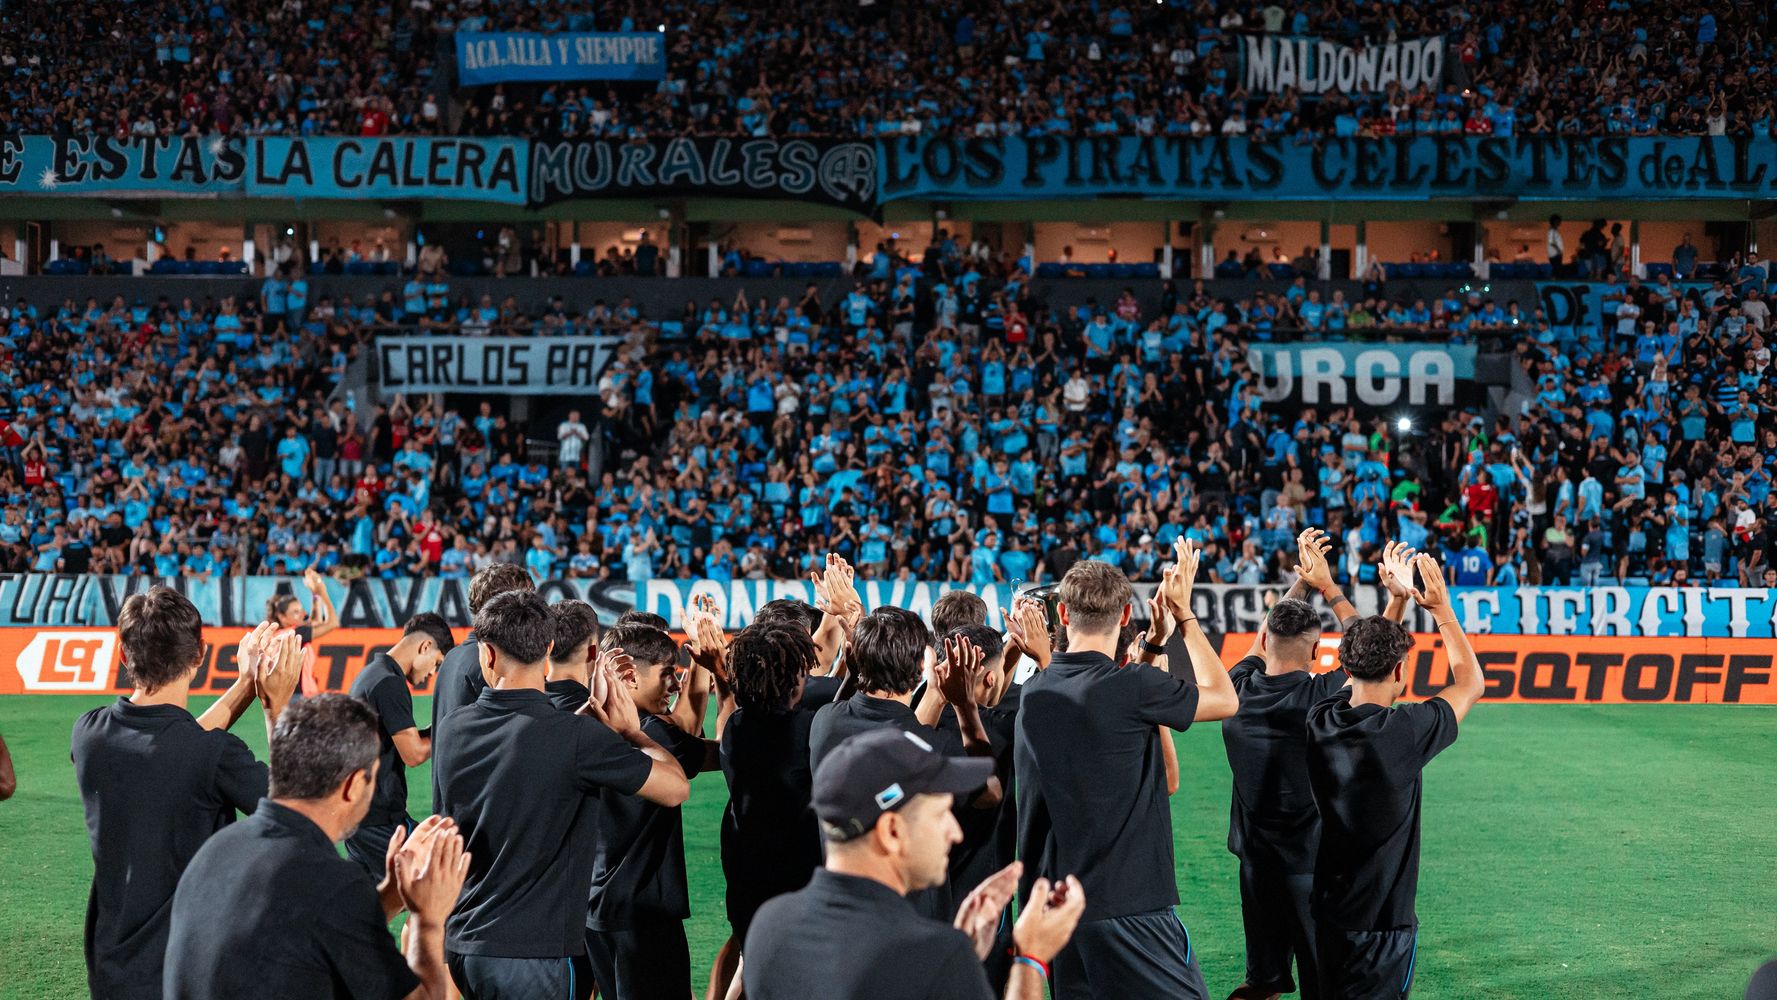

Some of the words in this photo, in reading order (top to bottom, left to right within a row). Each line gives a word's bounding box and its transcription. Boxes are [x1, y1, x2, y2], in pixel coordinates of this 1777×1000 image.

[556, 38, 569, 65] Y
[575, 36, 659, 65] SIEMPRE
[1246, 35, 1443, 94] MALDONADO
[50, 133, 247, 184] ESTAS
[254, 138, 314, 186] LA
[332, 139, 520, 194] CALERA
[530, 138, 818, 202] MURALES
[882, 135, 1002, 193] LOS
[1018, 135, 1284, 190] PIRATAS
[1310, 136, 1629, 191] CELESTES
[381, 343, 532, 388] CARLOS
[1247, 347, 1455, 407] URCA
[1462, 555, 1480, 573] 10
